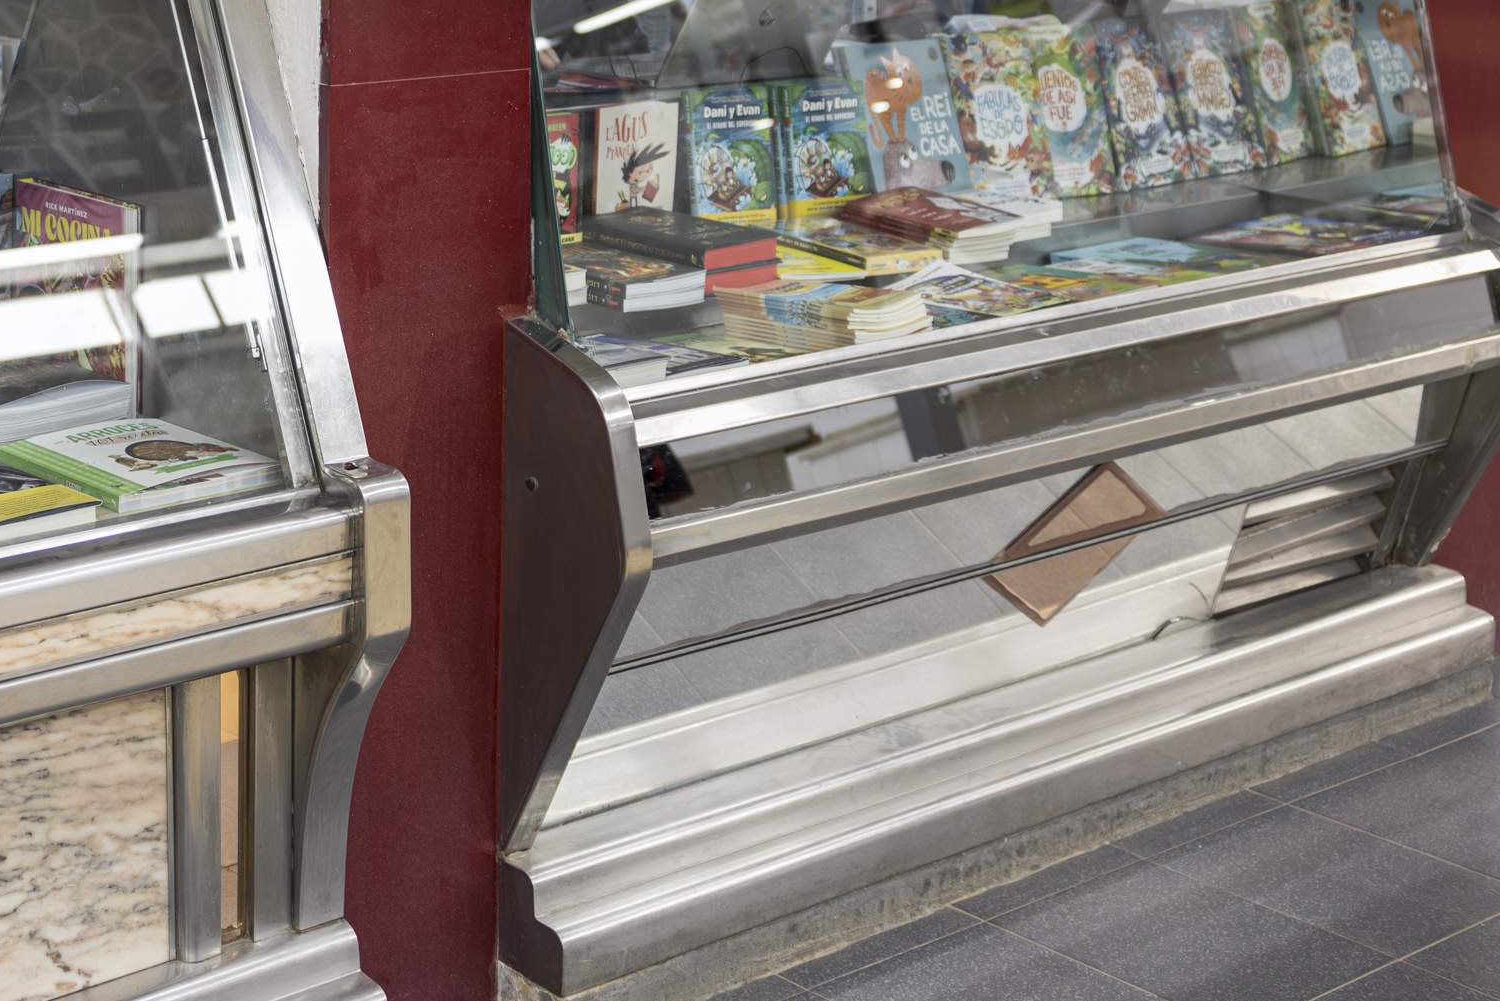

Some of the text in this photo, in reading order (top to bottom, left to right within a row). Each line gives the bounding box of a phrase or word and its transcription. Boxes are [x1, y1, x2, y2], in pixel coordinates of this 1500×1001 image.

[704, 104, 760, 119] Dani y Evan
[802, 97, 858, 113] Dani y Evan
[910, 105, 924, 122] EL
[1050, 104, 1073, 121] FUE
[919, 119, 949, 135] DE LA
[920, 135, 962, 157] CASA
[45, 201, 88, 218] RICK MARTÍNEZ
[21, 206, 41, 237] MI
[65, 422, 160, 444] ARROCES
